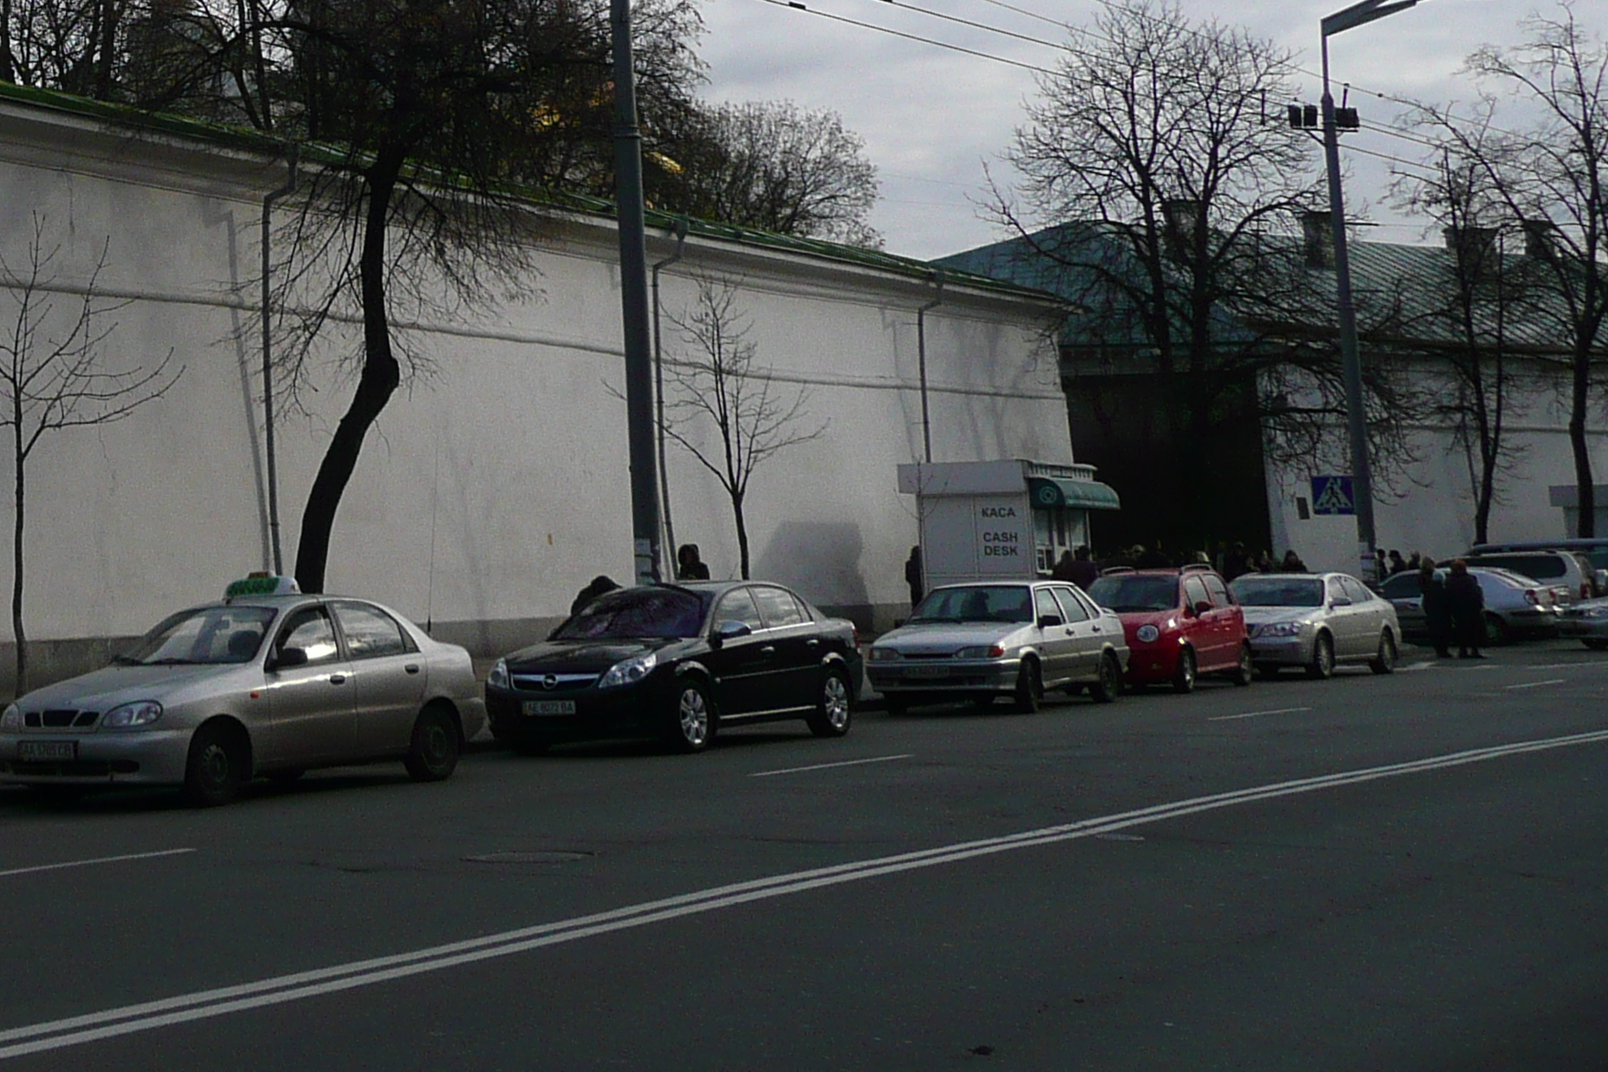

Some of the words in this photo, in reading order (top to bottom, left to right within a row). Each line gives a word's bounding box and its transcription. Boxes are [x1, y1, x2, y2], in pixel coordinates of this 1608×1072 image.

[982, 507, 1016, 518] КАСА
[983, 532, 1018, 543] CASH
[984, 545, 1018, 556] DESK
